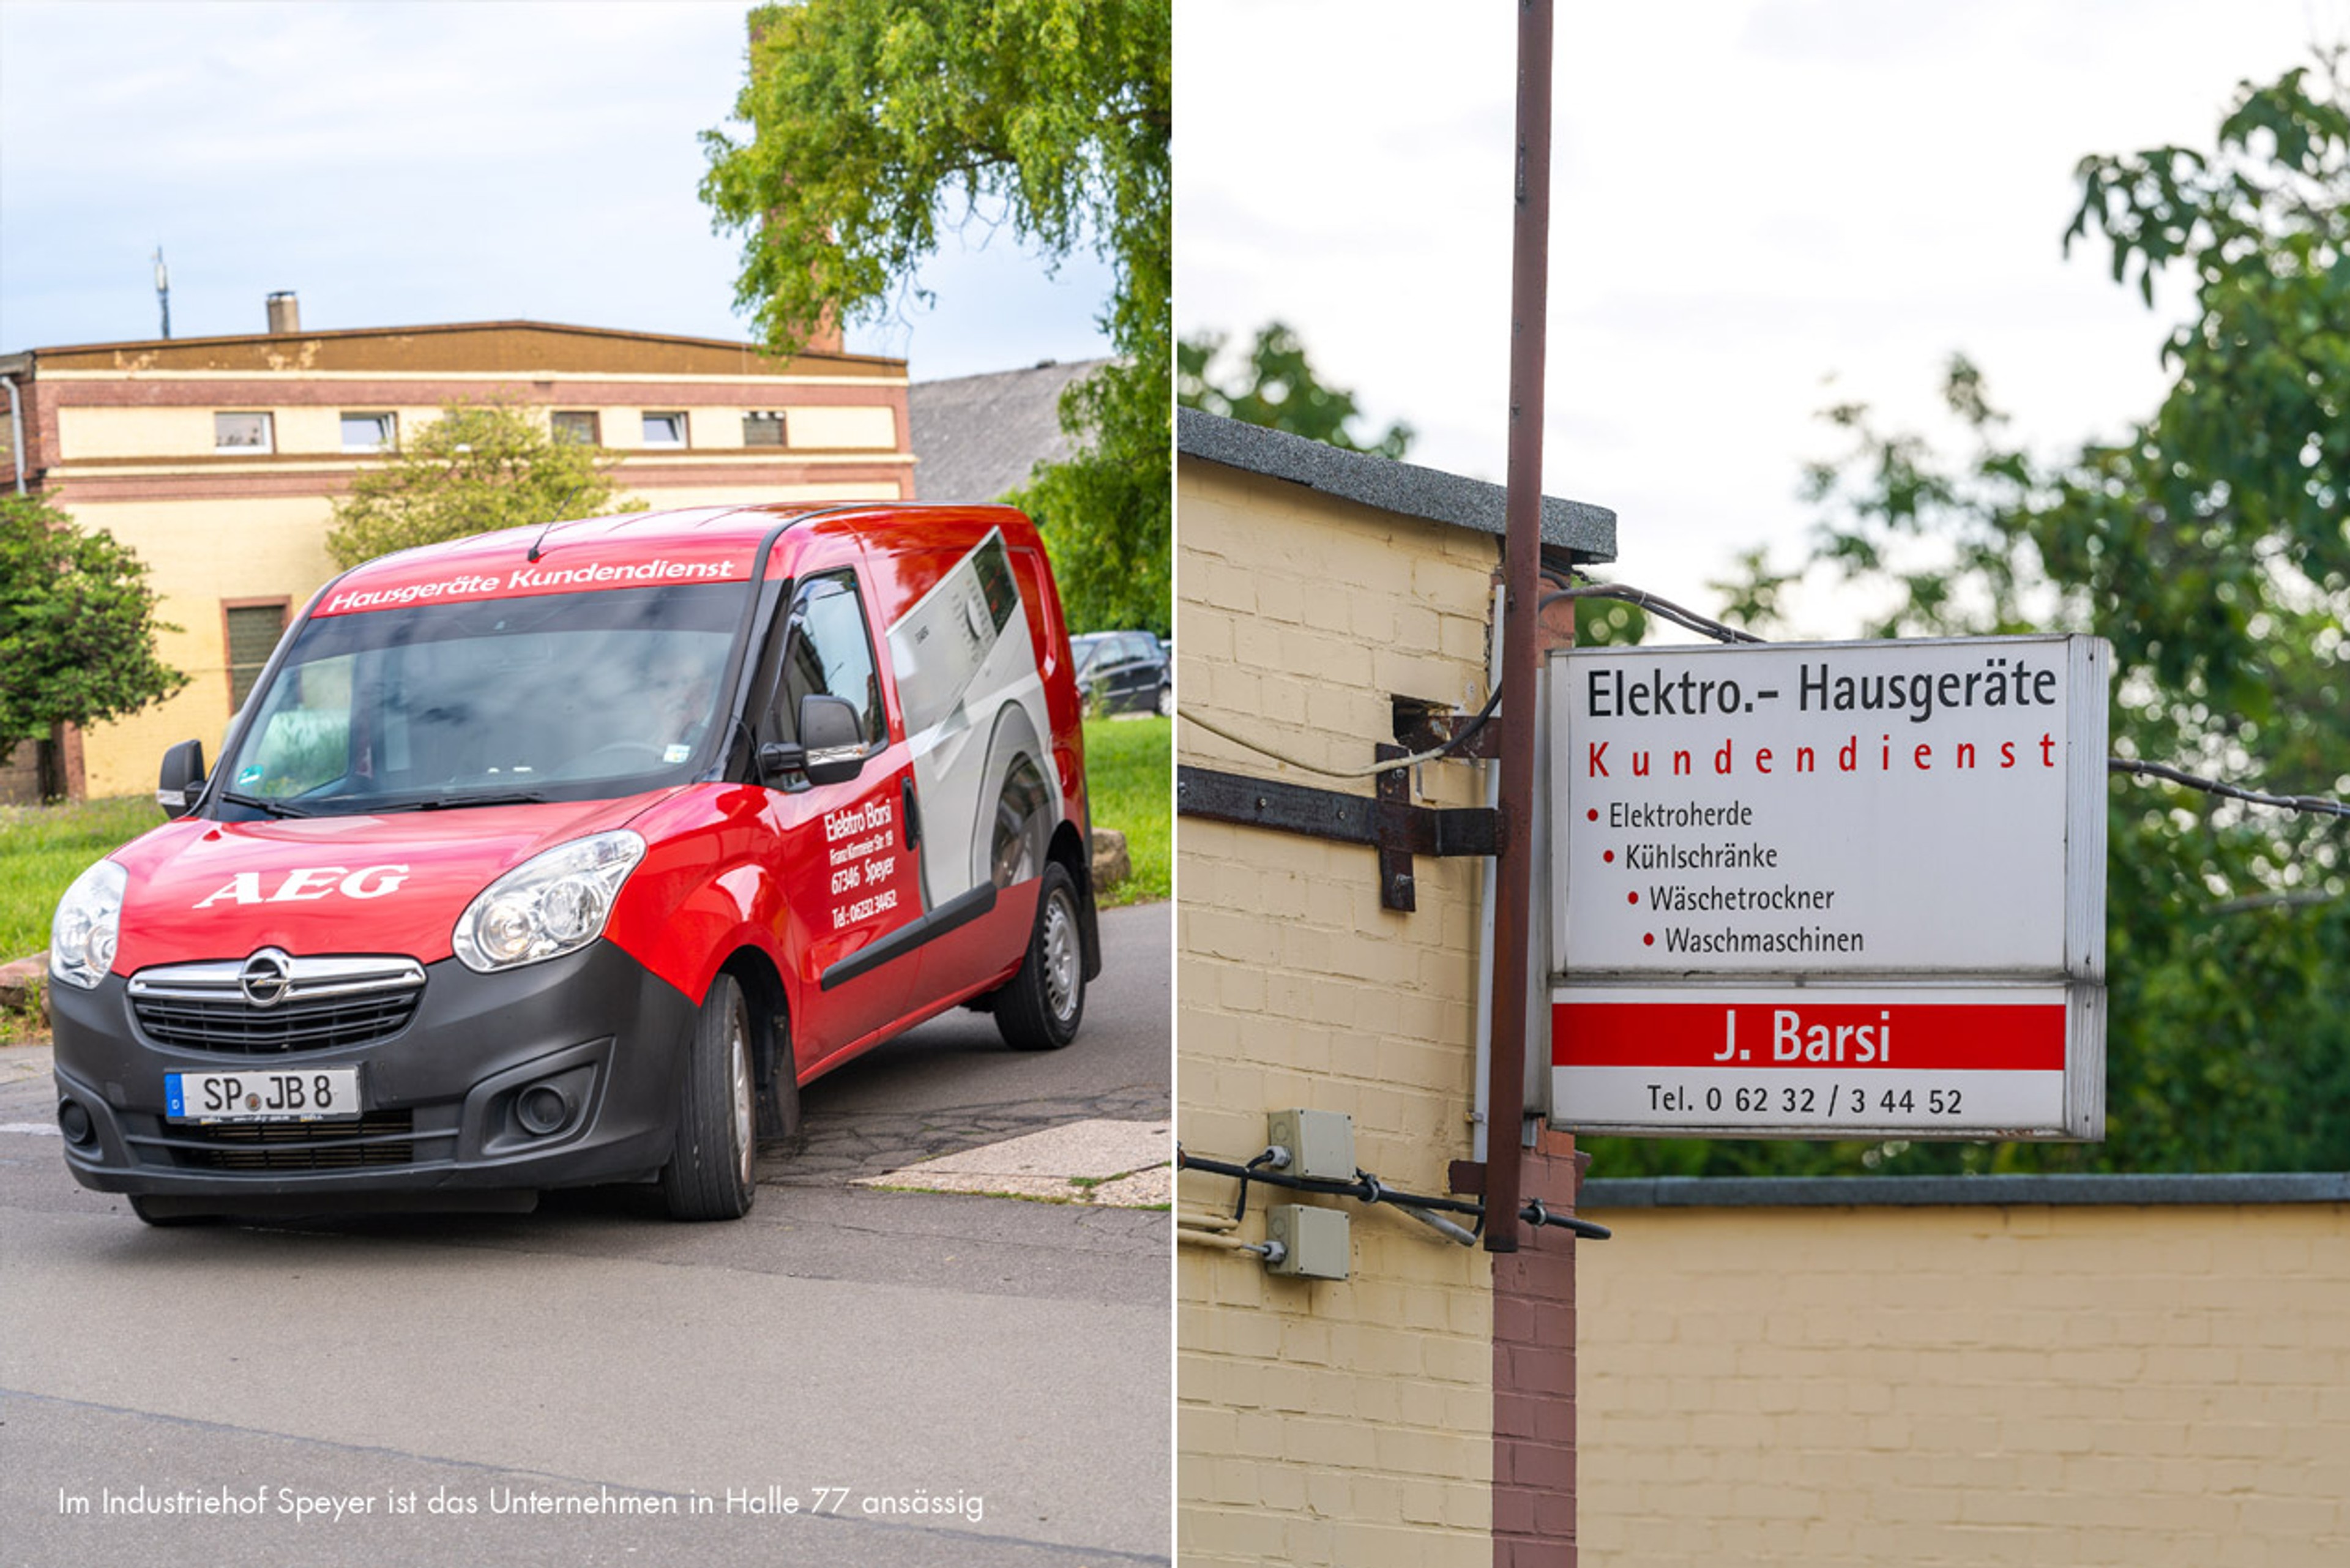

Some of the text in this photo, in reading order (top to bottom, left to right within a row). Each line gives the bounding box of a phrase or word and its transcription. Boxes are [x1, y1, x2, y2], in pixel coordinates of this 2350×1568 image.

[327, 558, 735, 612] Hausgeräte Kundendienst
[1799, 657, 2056, 723] Hausgeräte
[824, 798, 892, 842] Elektro Barsi
[1610, 800, 1753, 828] Elektroherde
[1625, 842, 1778, 870] Kühlschränke
[192, 864, 410, 909] AEG
[831, 856, 895, 895] 67346 Speyer
[1649, 884, 1835, 911] Wäschetrockner
[1665, 925, 1863, 954] Waschmaschinen
[1713, 1009, 1890, 1062] J. Barsi
[203, 1075, 332, 1111] SP JB 8
[1646, 1084, 1694, 1112] Tel.
[1706, 1086, 1723, 1112] 0
[1735, 1087, 1768, 1113] 62
[1781, 1087, 1815, 1113] 32
[1851, 1088, 1866, 1114] 3
[1879, 1089, 1915, 1114] 44
[1928, 1089, 1962, 1115] 52
